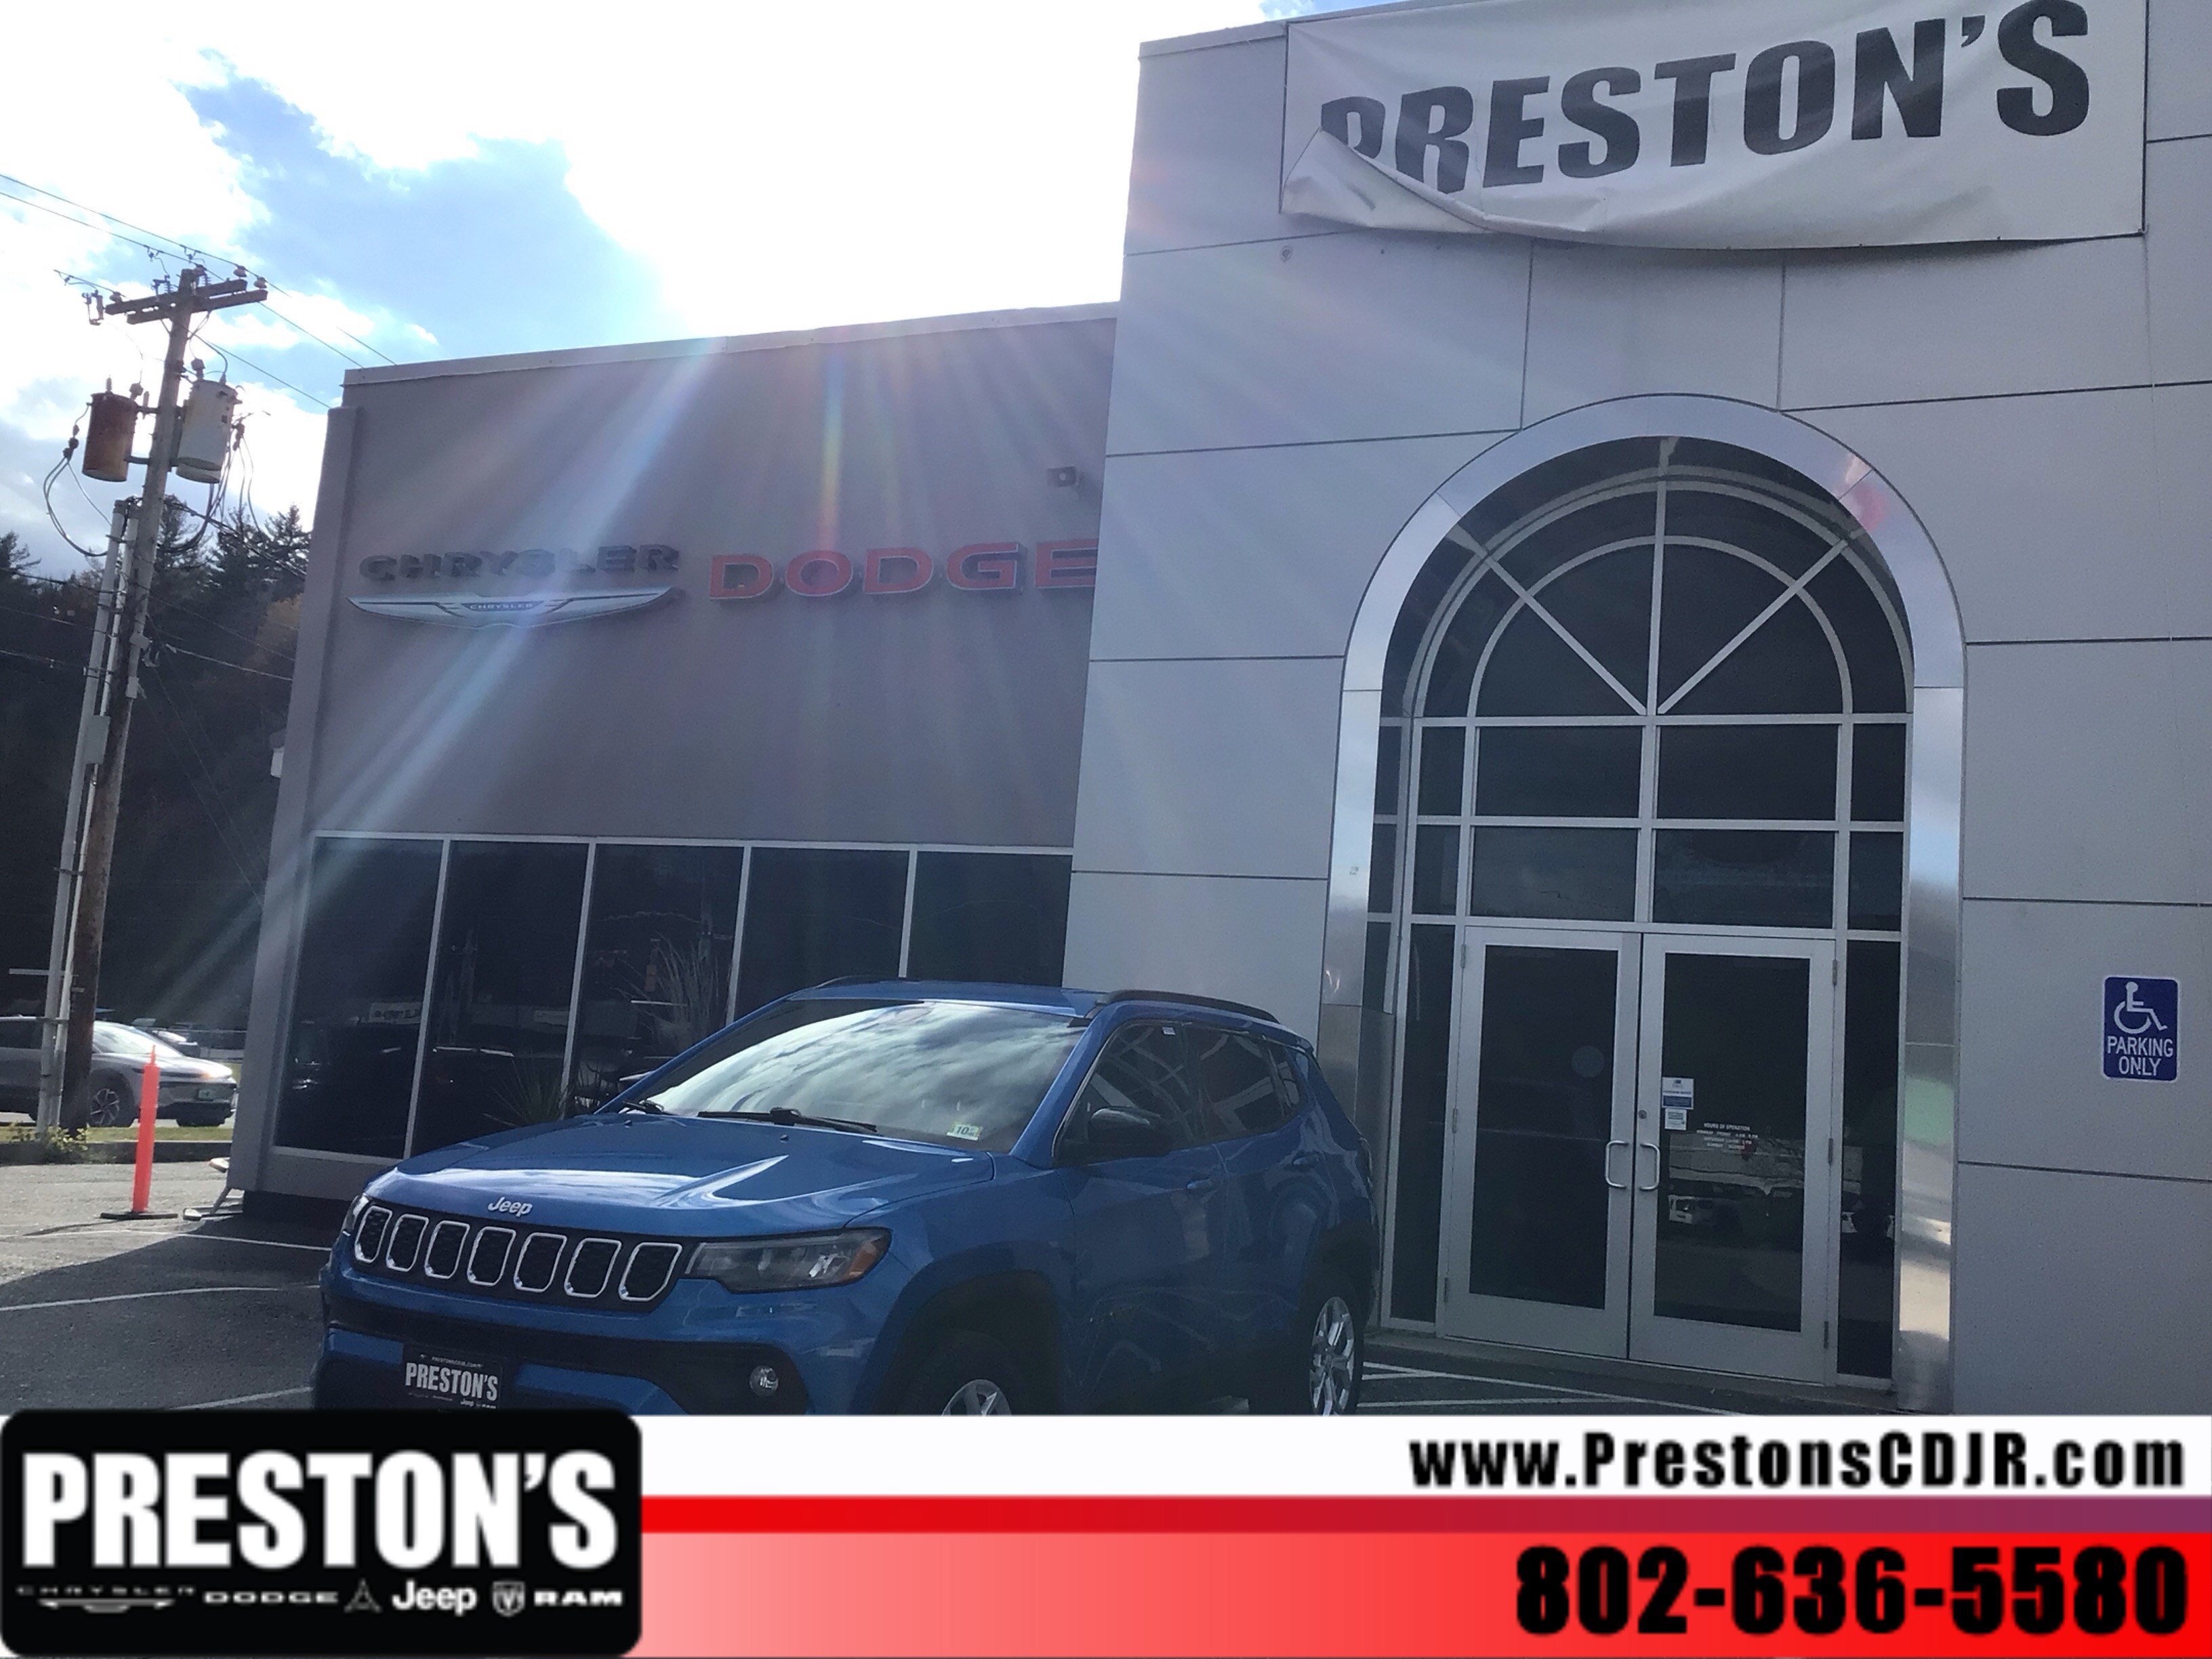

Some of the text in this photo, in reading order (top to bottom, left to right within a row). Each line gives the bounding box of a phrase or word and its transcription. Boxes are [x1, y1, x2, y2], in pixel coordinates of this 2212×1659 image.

[359, 543, 680, 582] CHRYSLER
[710, 538, 1099, 600] DODGE
[2107, 1036, 2173, 1057] PARKING
[2118, 1056, 2161, 1076] ONLY
[957, 1126, 969, 1134] 10
[488, 1197, 533, 1217] Jeep
[405, 1362, 498, 1401] PRESTON'S
